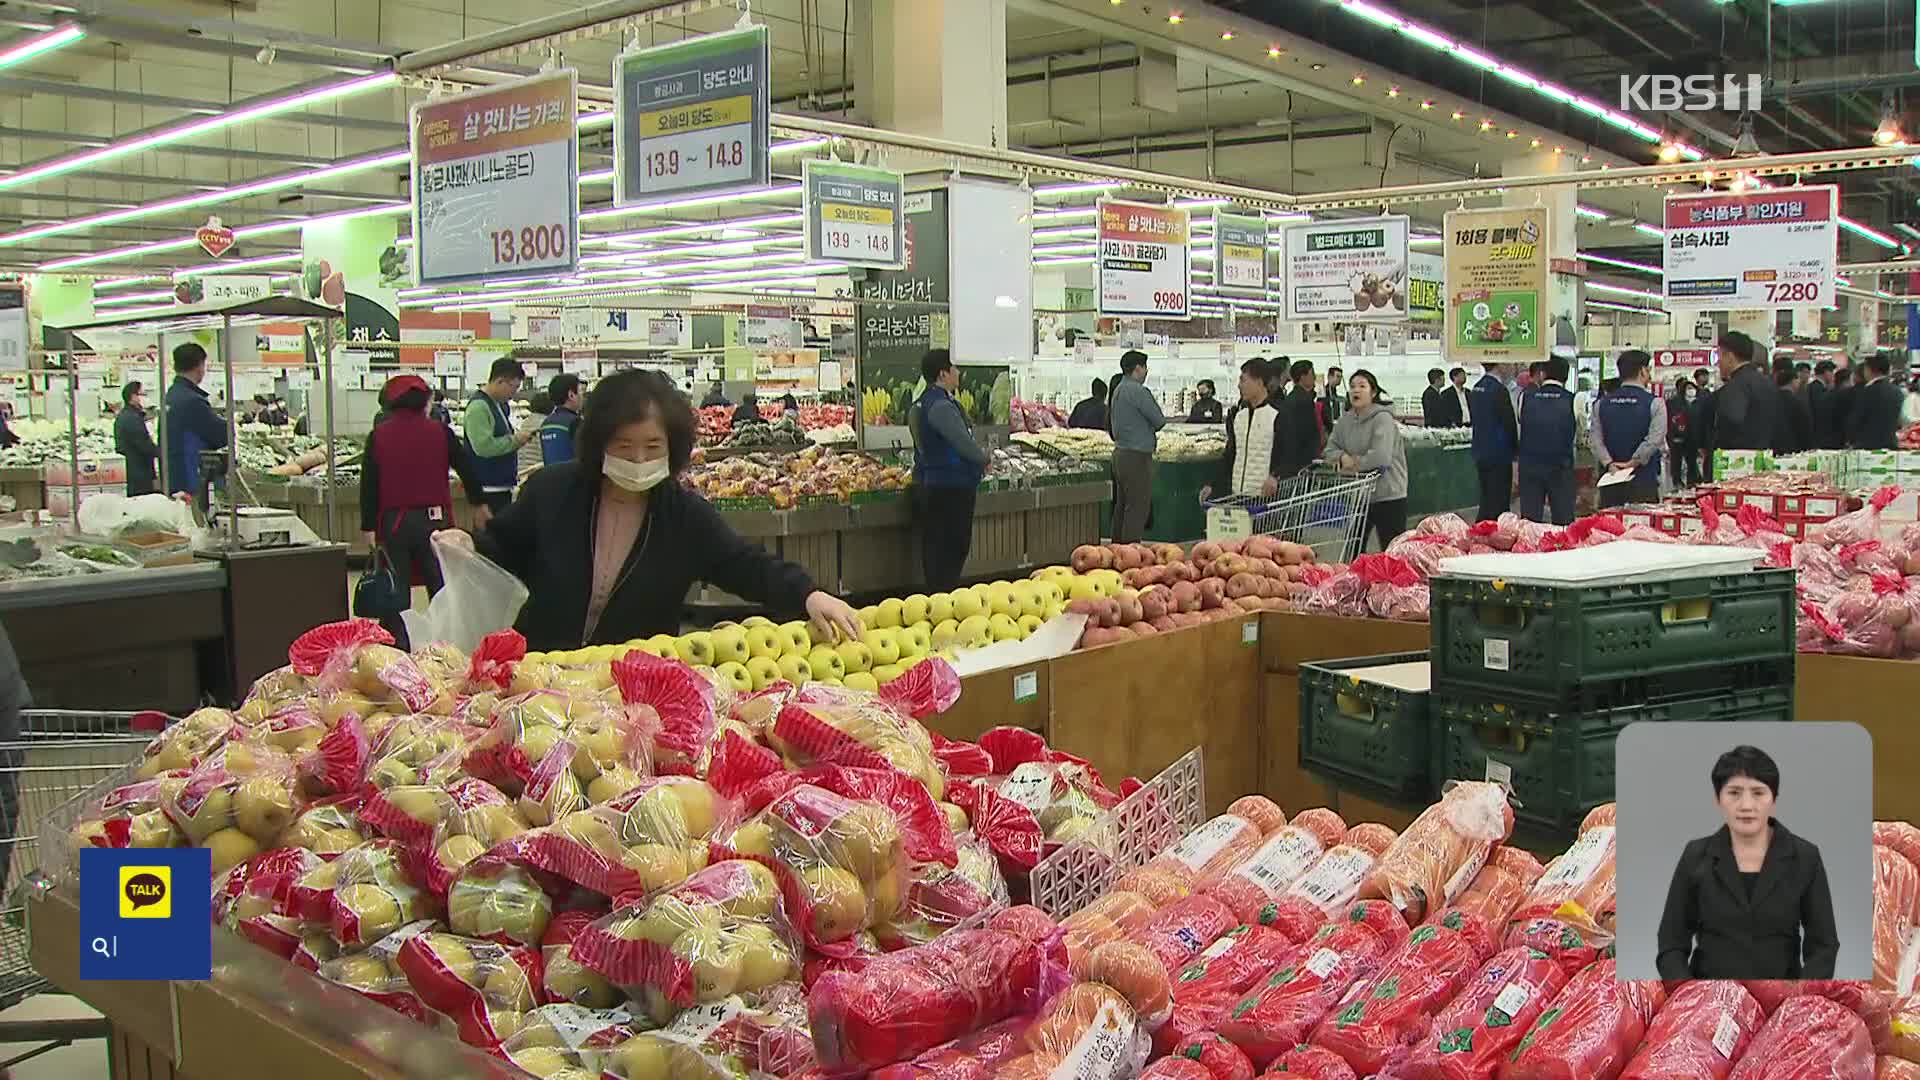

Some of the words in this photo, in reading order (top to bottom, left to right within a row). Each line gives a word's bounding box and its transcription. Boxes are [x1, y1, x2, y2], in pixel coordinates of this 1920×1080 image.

[704, 70, 727, 90] 당도
[729, 63, 753, 85] 안내
[464, 111, 481, 142] 살
[484, 103, 531, 137] 맛나는
[646, 150, 680, 178] 13.9
[706, 140, 743, 169] 14.8
[491, 223, 565, 265] 13,800
[827, 231, 849, 248] 13.9
[867, 235, 889, 252] 14.8
[1355, 231, 1377, 247] 과일
[1455, 229, 1488, 246] 1회용
[1103, 241, 1120, 257] 사과
[1154, 291, 1184, 310] 9,980
[1765, 283, 1818, 303] 7,280
[865, 315, 929, 337] 우리농산물
